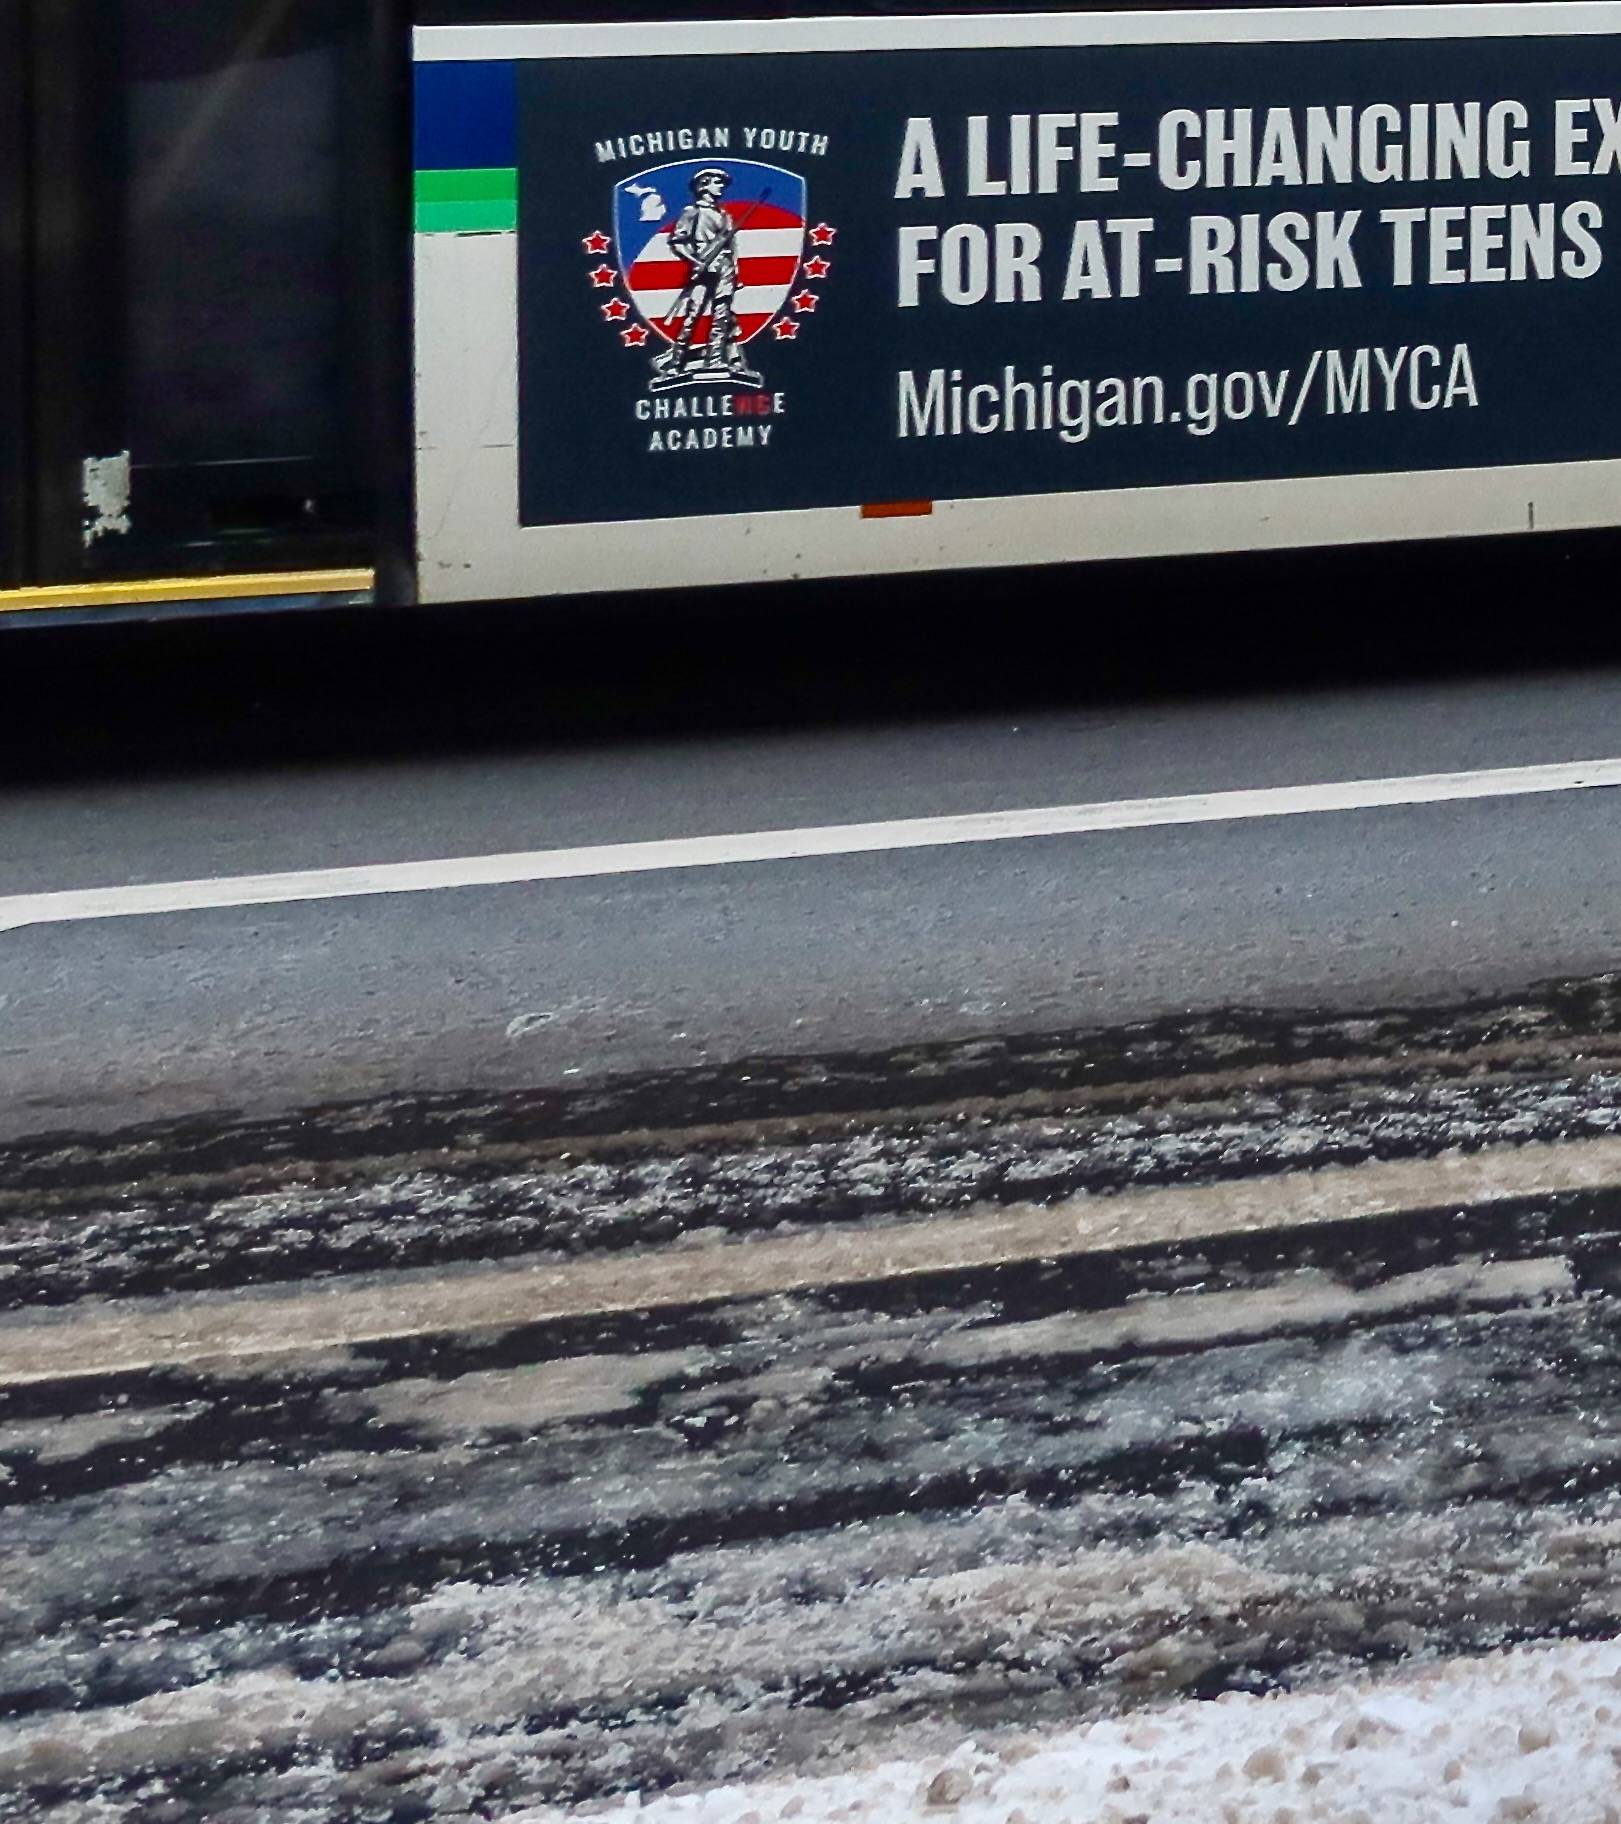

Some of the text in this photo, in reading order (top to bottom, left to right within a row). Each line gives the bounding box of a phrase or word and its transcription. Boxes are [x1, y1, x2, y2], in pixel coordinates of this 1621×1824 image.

[595, 127, 829, 164] MICHIGAN YOUTH
[893, 117, 946, 199] A
[966, 99, 1531, 197] LIFE-CHANGING
[897, 200, 1603, 308] FOR AT-RISK TEENS
[649, 424, 772, 452] ACADEMY
[898, 342, 1479, 444] Michigan.gov/MYCA
